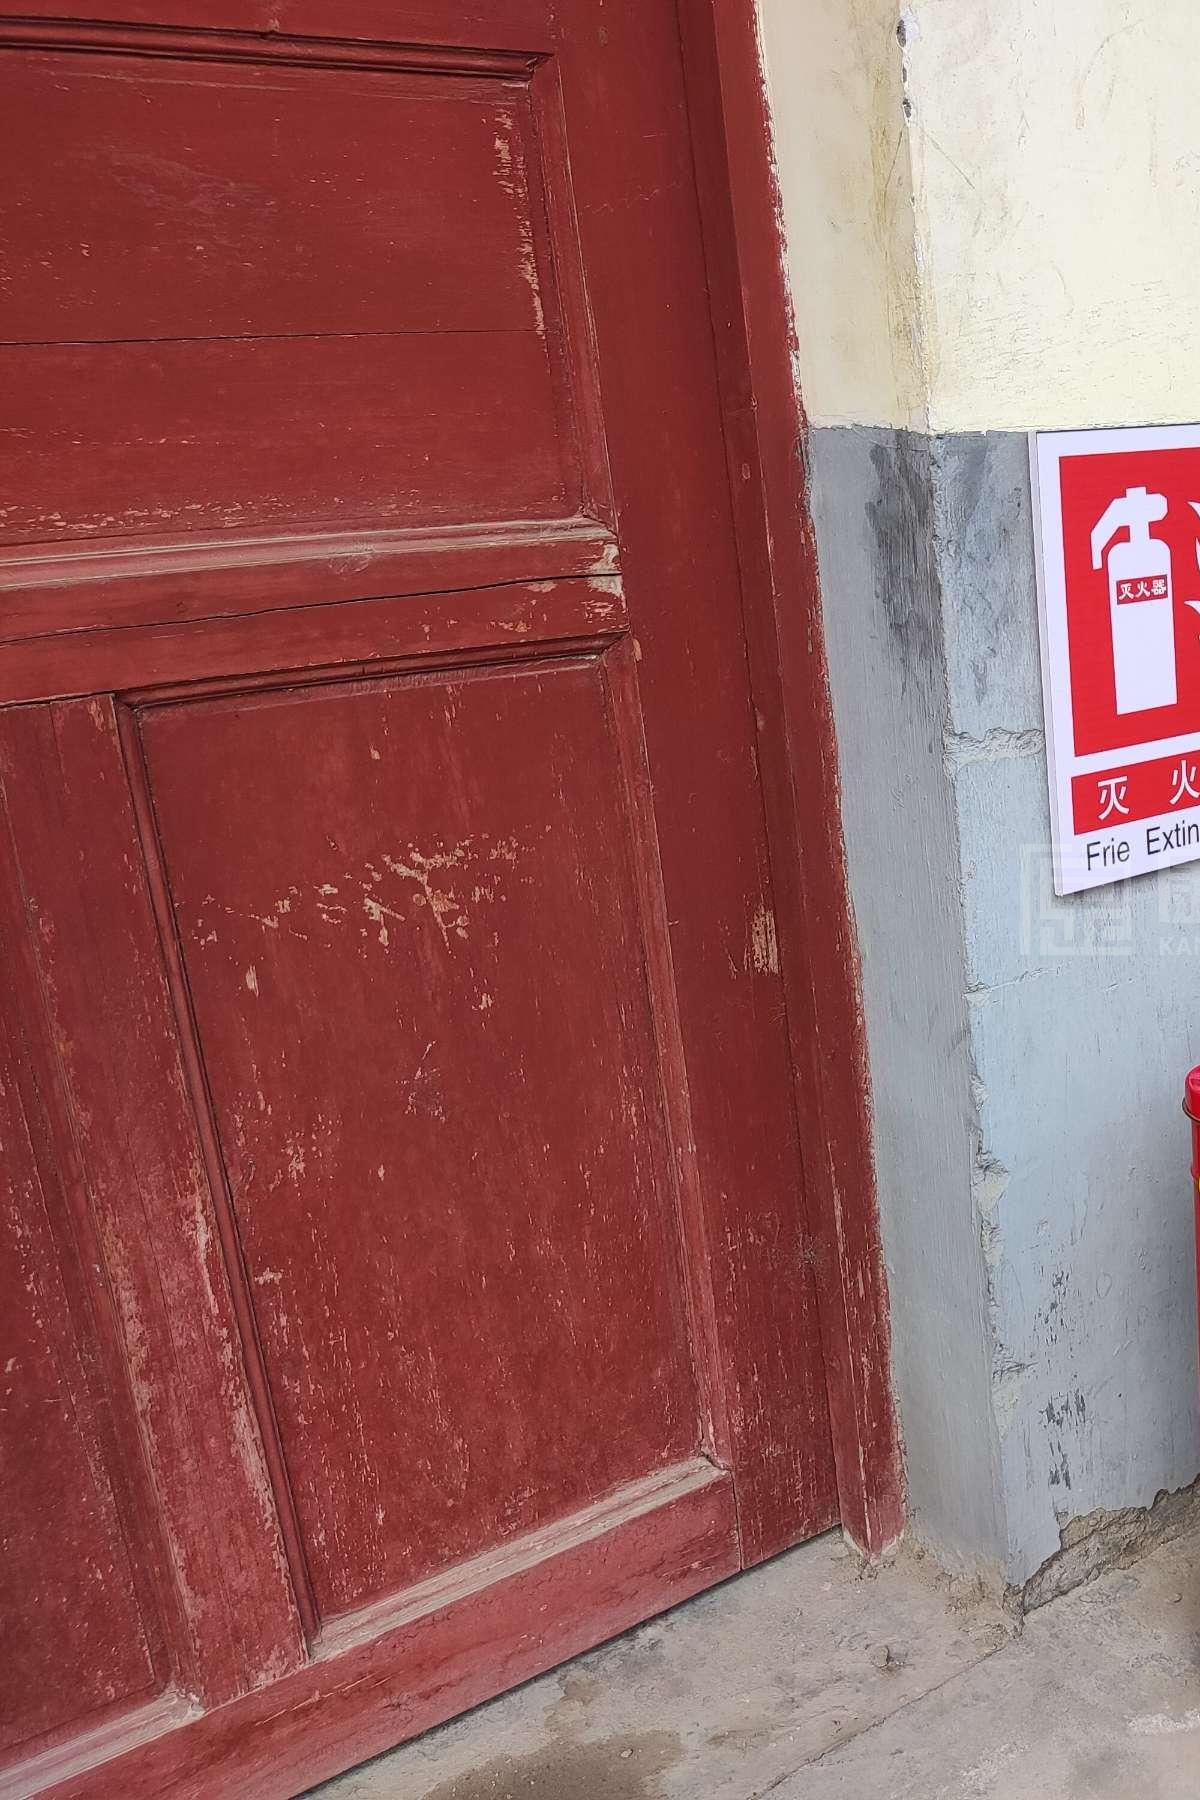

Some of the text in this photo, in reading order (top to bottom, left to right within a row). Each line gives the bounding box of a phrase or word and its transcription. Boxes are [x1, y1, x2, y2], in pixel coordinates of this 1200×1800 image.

[1118, 578, 1167, 600] 灭火器
[1086, 837, 1131, 872] Frie
